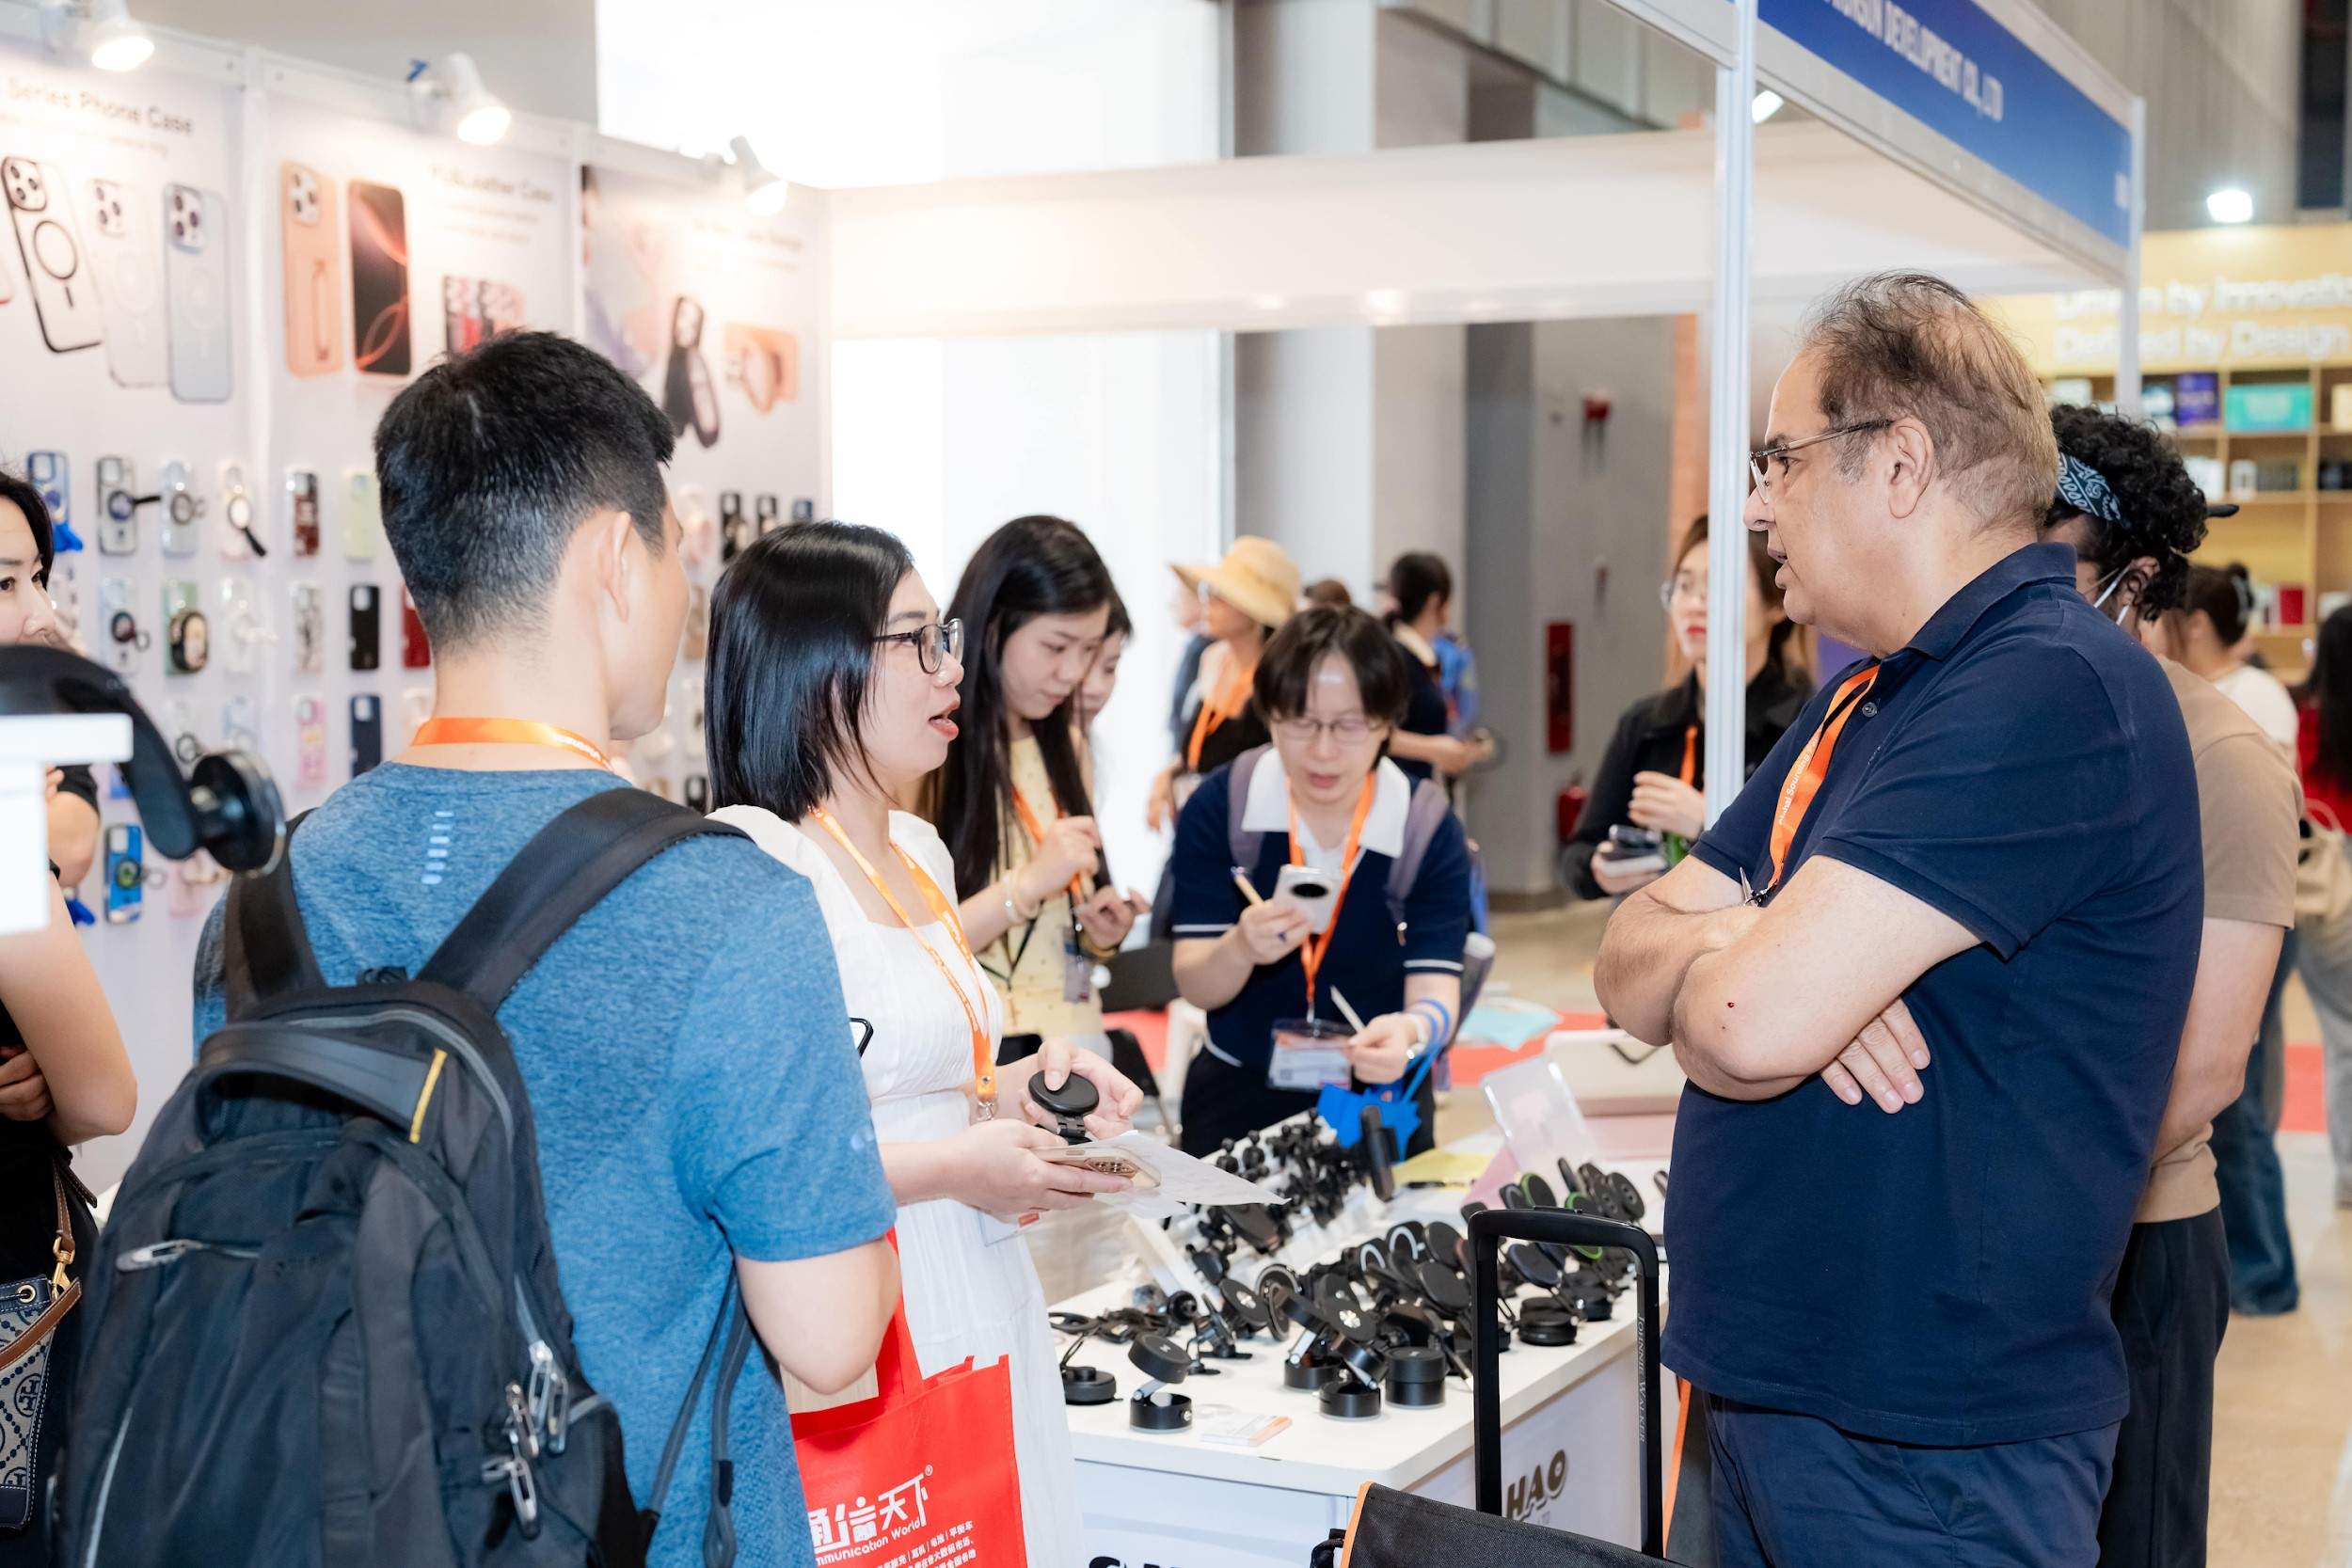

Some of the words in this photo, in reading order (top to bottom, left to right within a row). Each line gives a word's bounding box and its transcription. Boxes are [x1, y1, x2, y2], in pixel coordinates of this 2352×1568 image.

[147, 104, 194, 135] Case
[2232, 320, 2348, 362] Design
[1506, 1449, 1566, 1520] HAO
[890, 1516, 922, 1541] World
